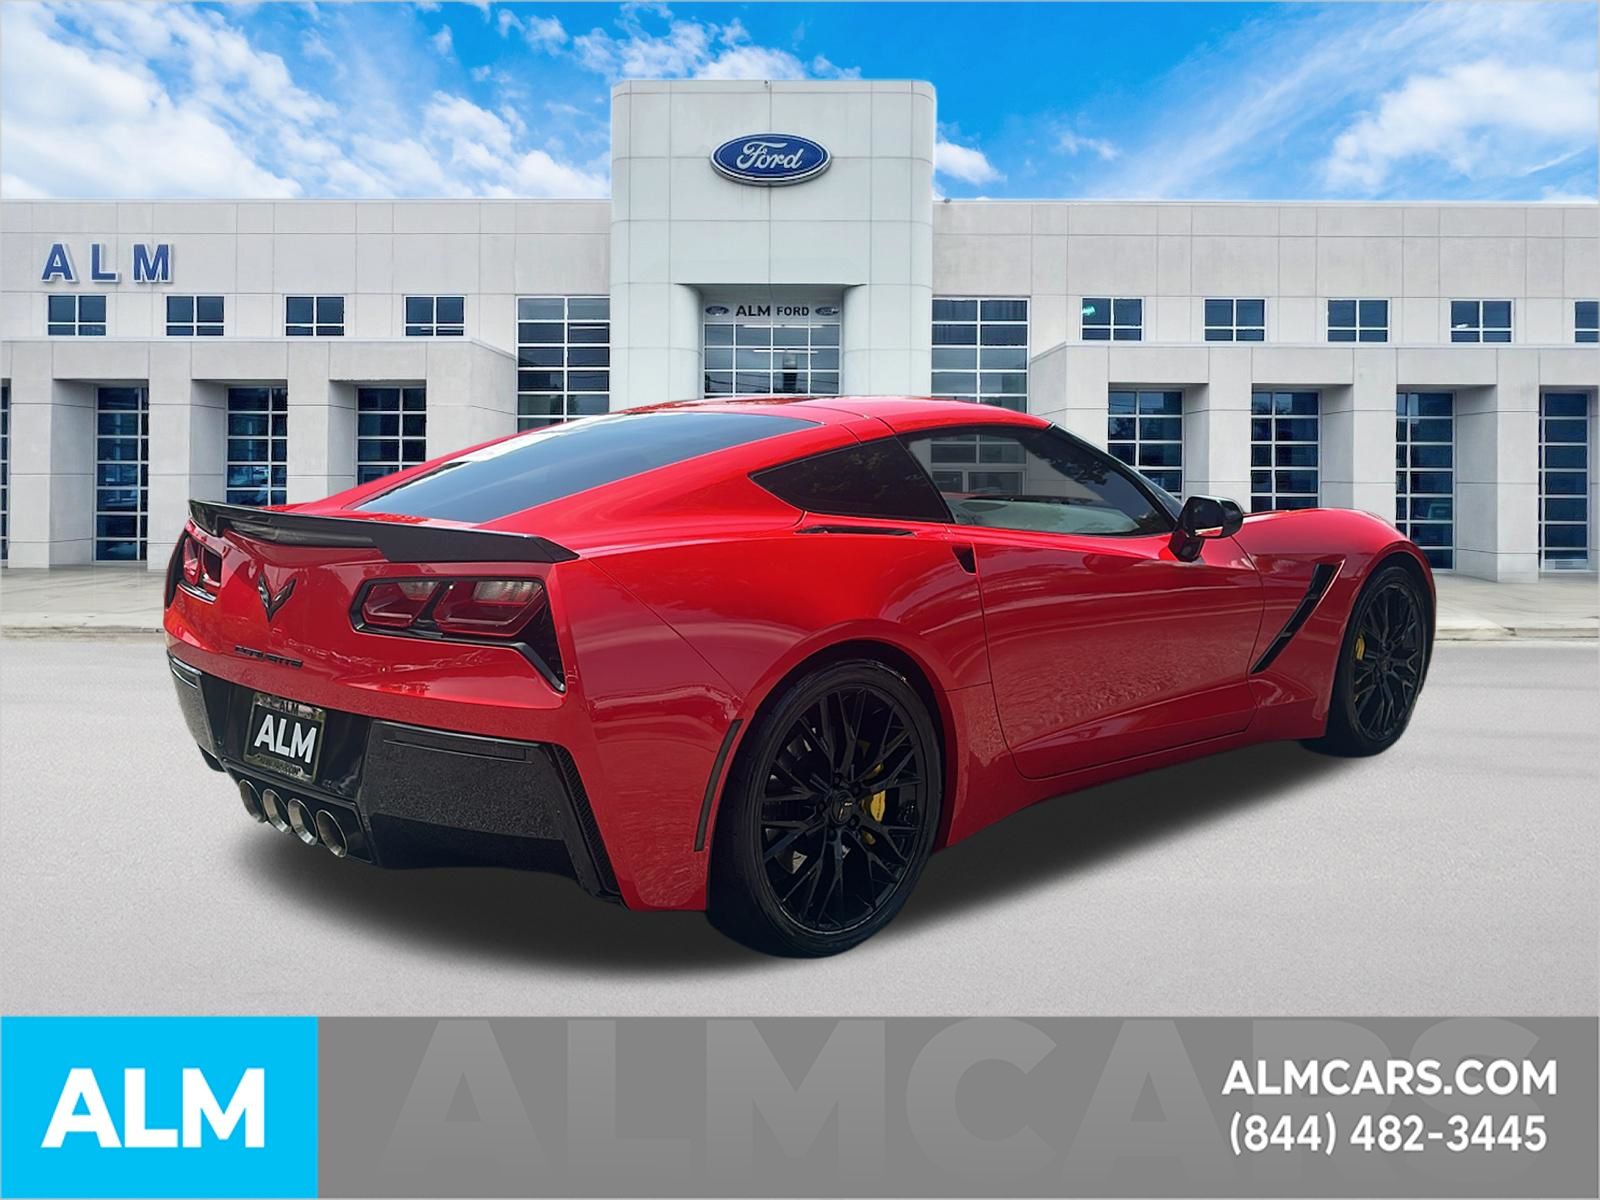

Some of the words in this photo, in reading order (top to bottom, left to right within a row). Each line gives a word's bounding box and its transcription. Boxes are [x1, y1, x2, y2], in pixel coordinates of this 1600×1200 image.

[736, 141, 804, 169] Ford
[41, 242, 173, 284] ALM
[735, 304, 771, 316] ALM
[776, 306, 810, 317] FORD
[254, 713, 317, 764] ALM
